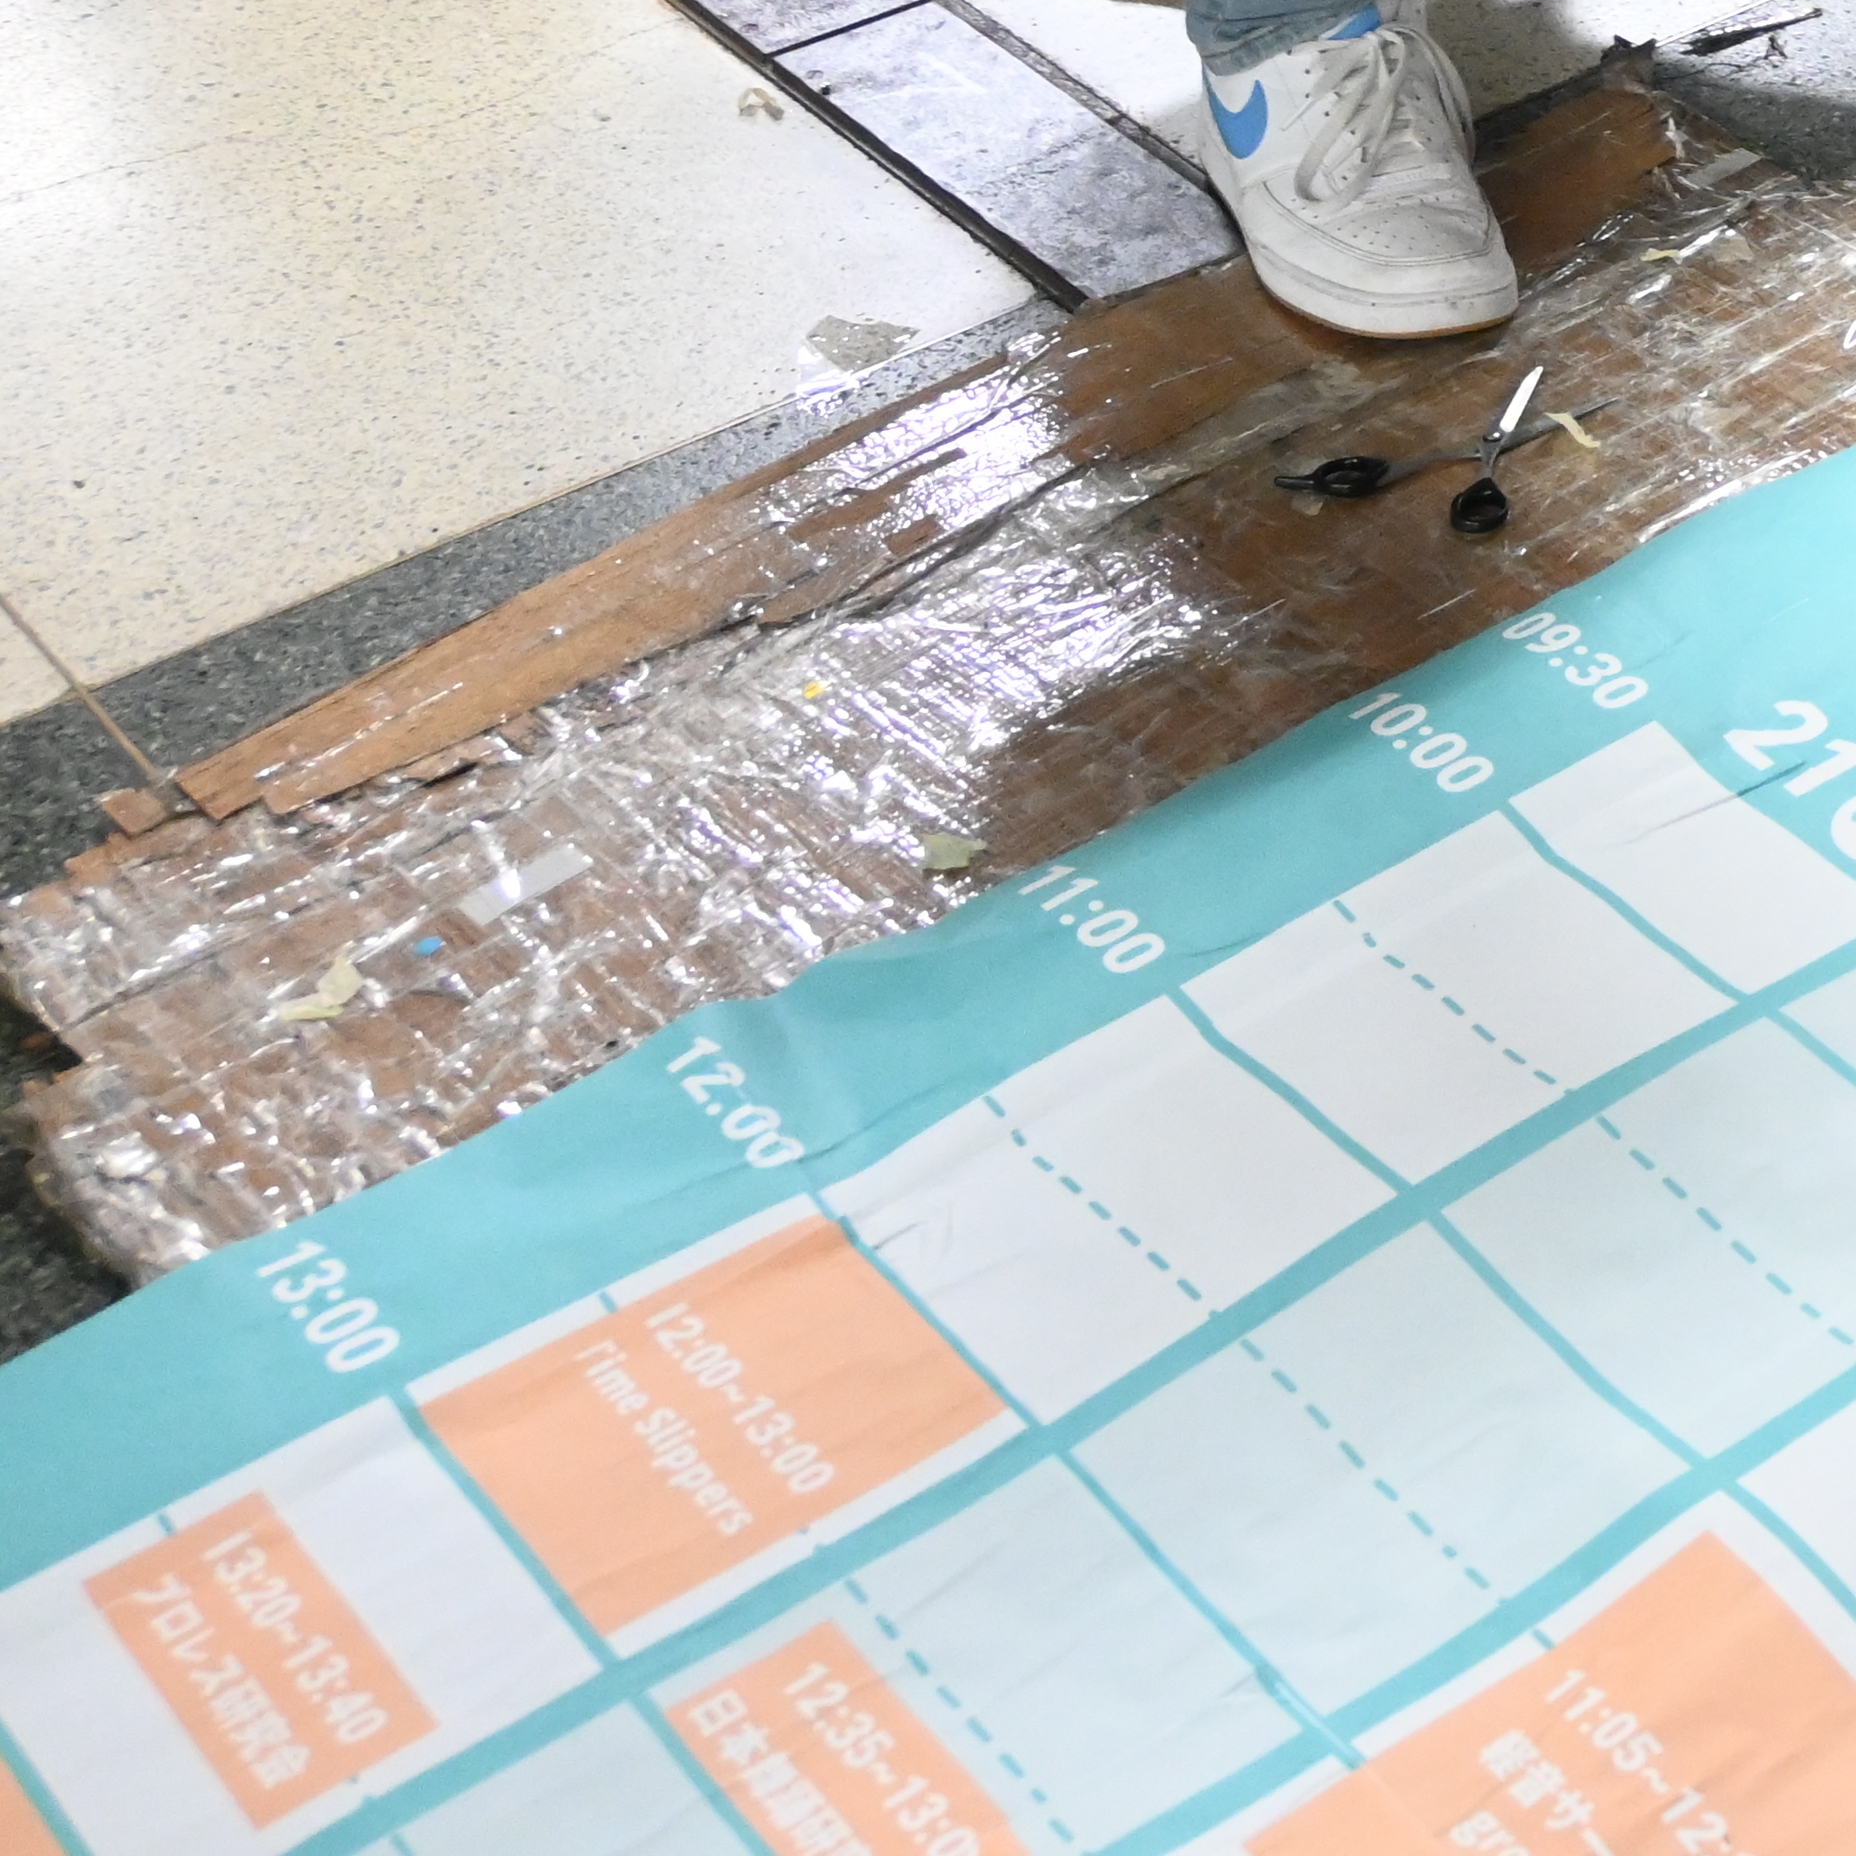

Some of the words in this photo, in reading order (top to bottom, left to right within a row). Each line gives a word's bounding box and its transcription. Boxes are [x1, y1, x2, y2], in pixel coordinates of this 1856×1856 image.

[1503, 611, 1648, 710] 09:30
[1349, 691, 1495, 793] 10:00
[1018, 864, 1165, 974] 11:00
[257, 1241, 400, 1373] 13:00
[634, 1406, 754, 1536] Slippers
